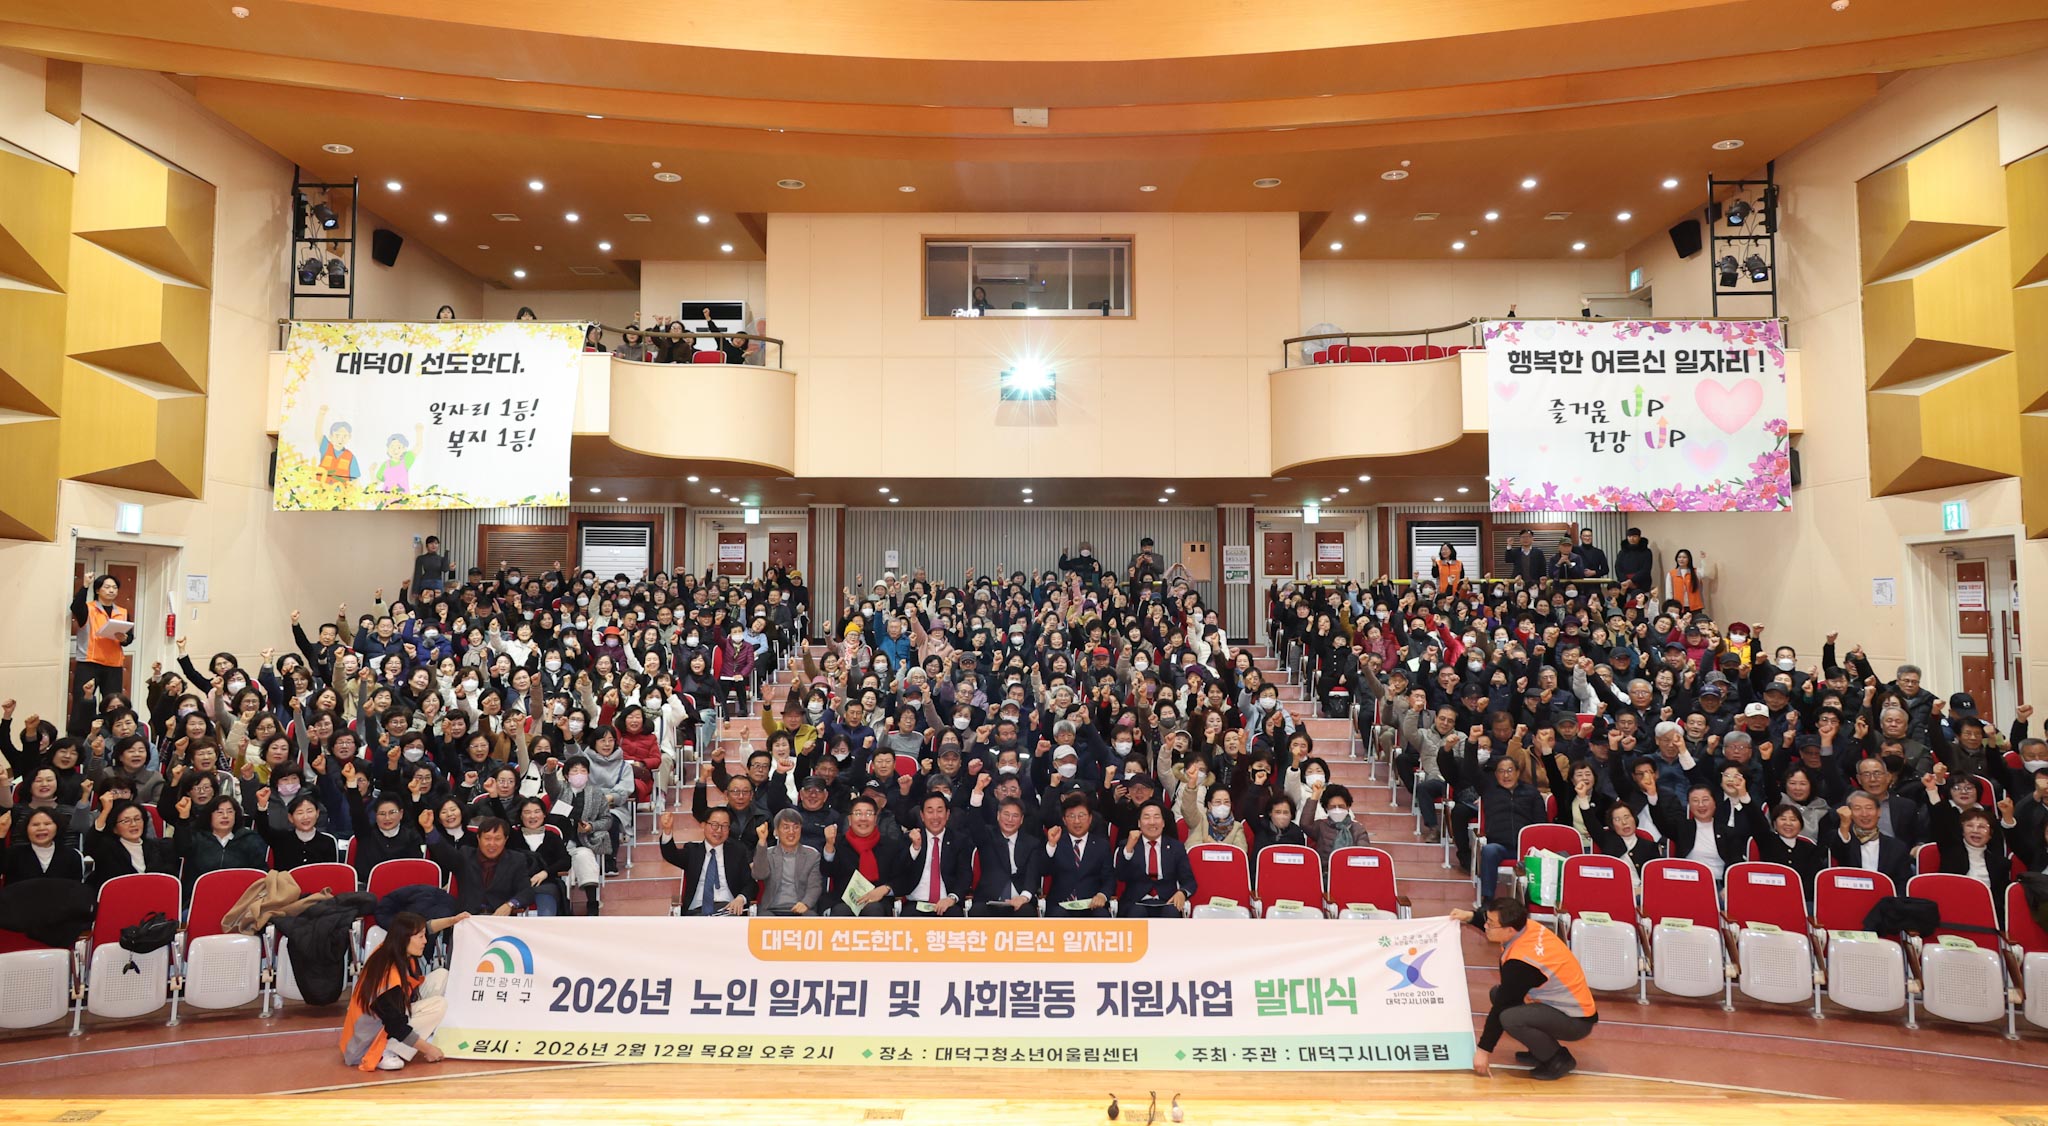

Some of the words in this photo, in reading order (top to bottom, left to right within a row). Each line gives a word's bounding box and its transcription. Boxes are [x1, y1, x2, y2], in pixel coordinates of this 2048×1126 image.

[336, 350, 412, 375] 대덕이
[421, 350, 525, 375] 선도한다.
[1508, 350, 1583, 374] 행복한
[1592, 350, 1666, 373] 어르신
[430, 402, 490, 425] 일자리
[500, 399, 539, 421] 1등!
[1549, 399, 1610, 424] 즐거움
[1622, 386, 1664, 417] UP
[447, 430, 486, 457] 복지
[497, 428, 536, 452] 1등!
[1585, 430, 1631, 453] 건강
[1645, 416, 1686, 449] UP
[762, 930, 823, 951] 대덕이
[831, 930, 918, 953] 선도한다.
[926, 930, 988, 952] 행복한
[994, 931, 1055, 952] 어르신
[1063, 931, 1132, 952] 일자리!
[474, 974, 533, 988] 대전광역시
[549, 977, 672, 1015] 2026년
[690, 979, 757, 1016] 노인
[769, 979, 867, 1017] 일자리
[889, 980, 920, 1017] 및
[940, 980, 1075, 1018] 사회활동
[1097, 981, 1232, 1017] 지원사업
[1255, 977, 1357, 1016] 발대식
[1386, 997, 1444, 1005] 대덕구시니어클럽
[473, 1040, 509, 1053] 일시
[534, 1041, 608, 1056] 2026년
[615, 1044, 646, 1056] 2월
[655, 1044, 693, 1057] 12일
[701, 1045, 753, 1058] 목요일
[760, 1045, 795, 1059] 오후
[803, 1046, 833, 1059] 2시
[880, 1047, 912, 1060] 장소
[936, 1047, 1137, 1062] 대덕구청소년어울림센터
[1299, 1044, 1449, 1062] 대덕구시니어클럽
